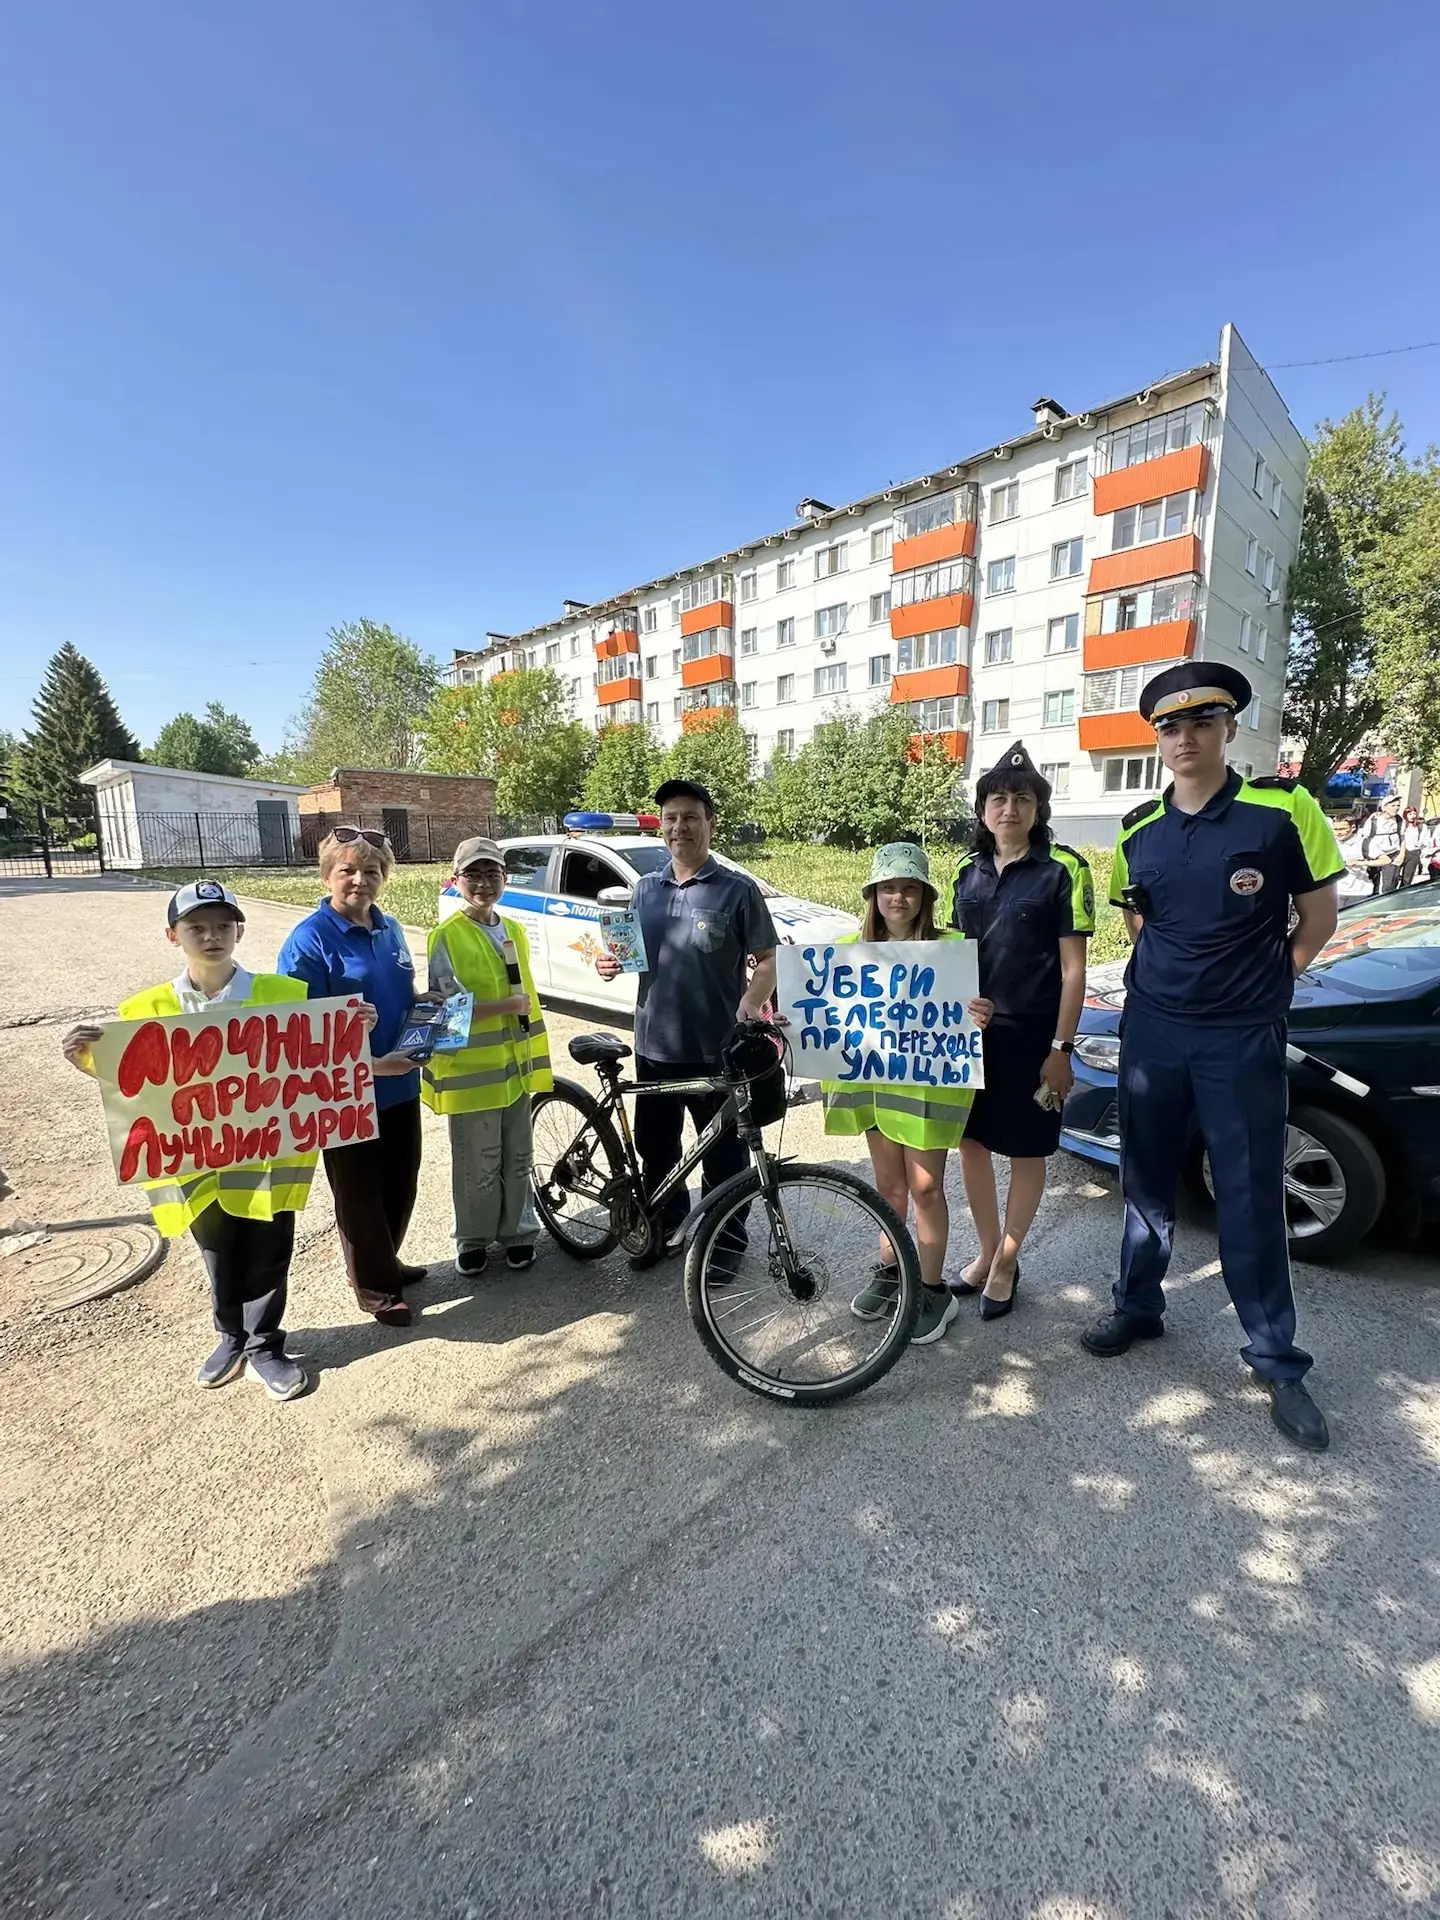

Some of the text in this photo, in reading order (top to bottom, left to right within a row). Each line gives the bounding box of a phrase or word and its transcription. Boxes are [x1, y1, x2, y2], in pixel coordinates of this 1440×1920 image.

[571, 905, 613, 919] ПОЛИ
[772, 908, 836, 927] ДПС
[803, 947, 935, 998] УБЕРИ
[792, 998, 963, 1030] ТЕЛЕФОН
[118, 999, 364, 1097] ЛИЧНЫЙ
[801, 1026, 982, 1062] ПРИ ПЕРЕХОДЕ
[838, 1049, 970, 1086] УЛИЦЫ
